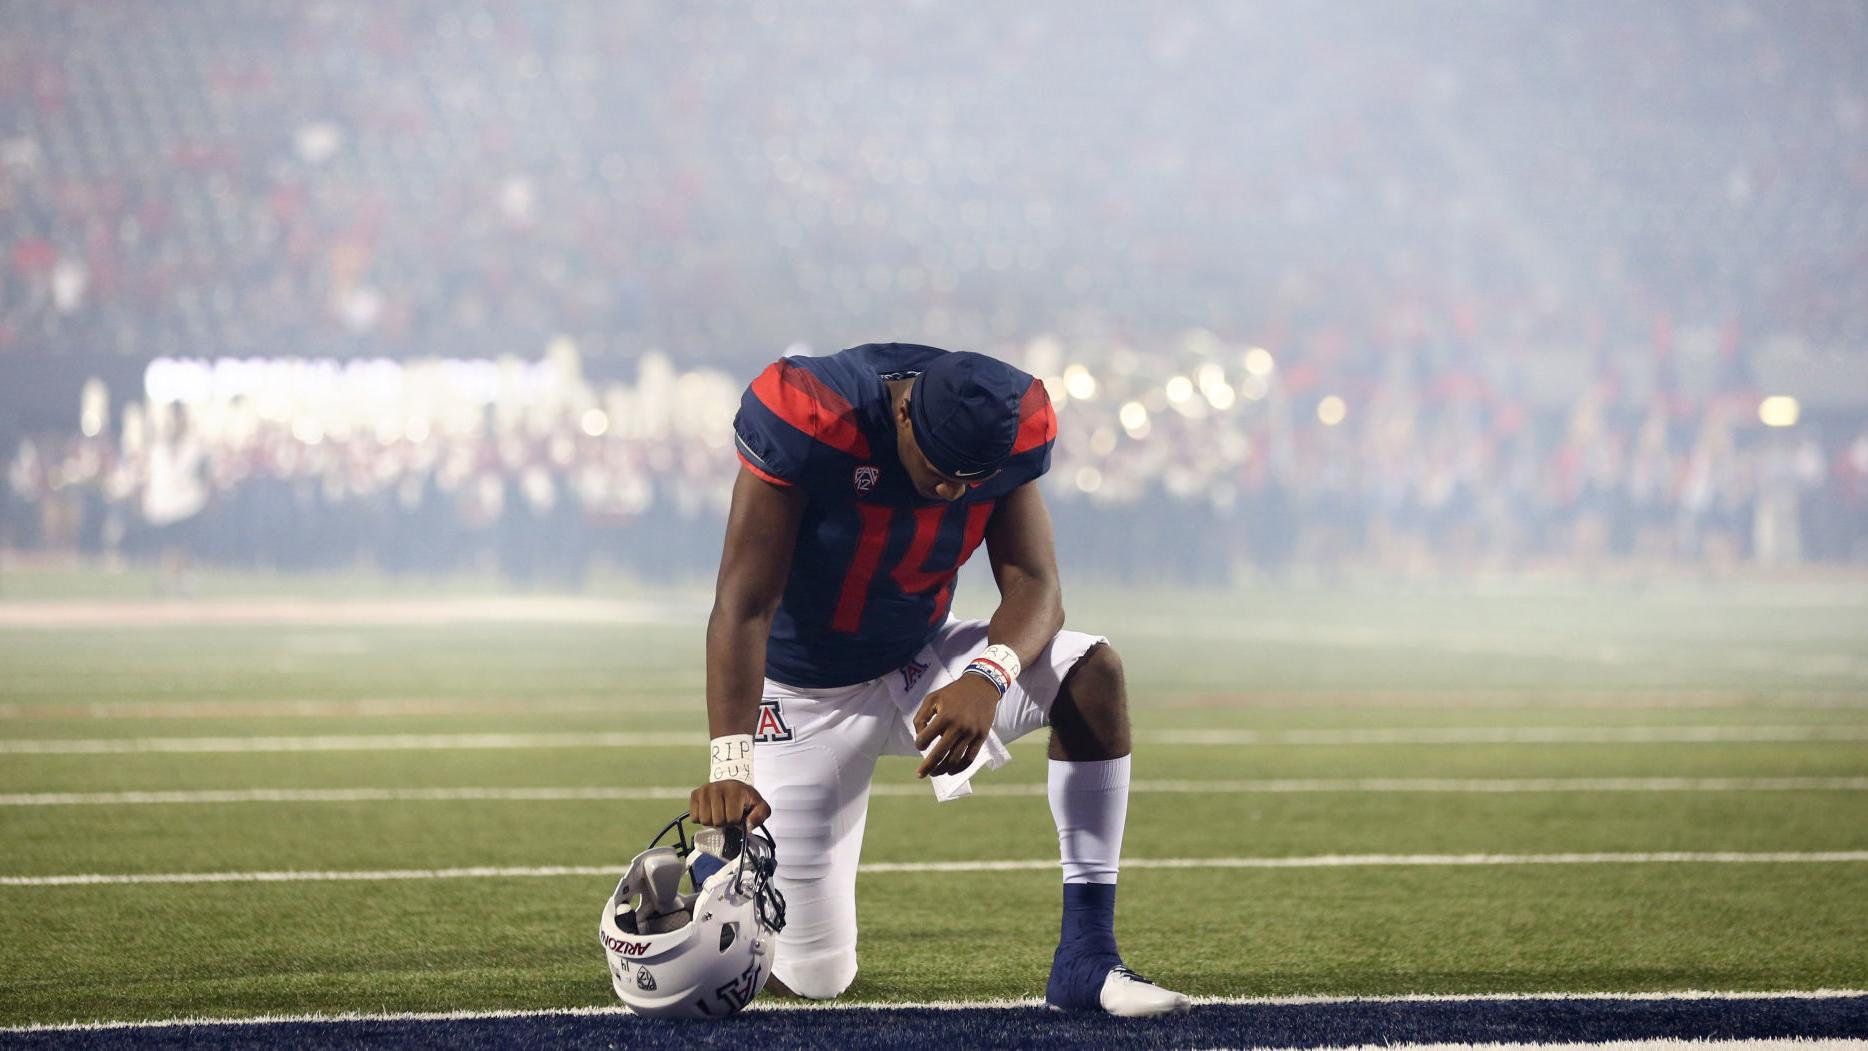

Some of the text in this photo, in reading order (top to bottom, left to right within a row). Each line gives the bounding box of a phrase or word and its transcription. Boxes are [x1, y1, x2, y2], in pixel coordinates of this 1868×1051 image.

[854, 466, 879, 485] PAC
[857, 479, 870, 490] 12
[832, 502, 994, 634] 14
[754, 701, 793, 742] A
[712, 741, 750, 764] RIP
[600, 931, 652, 956] ARIZON
